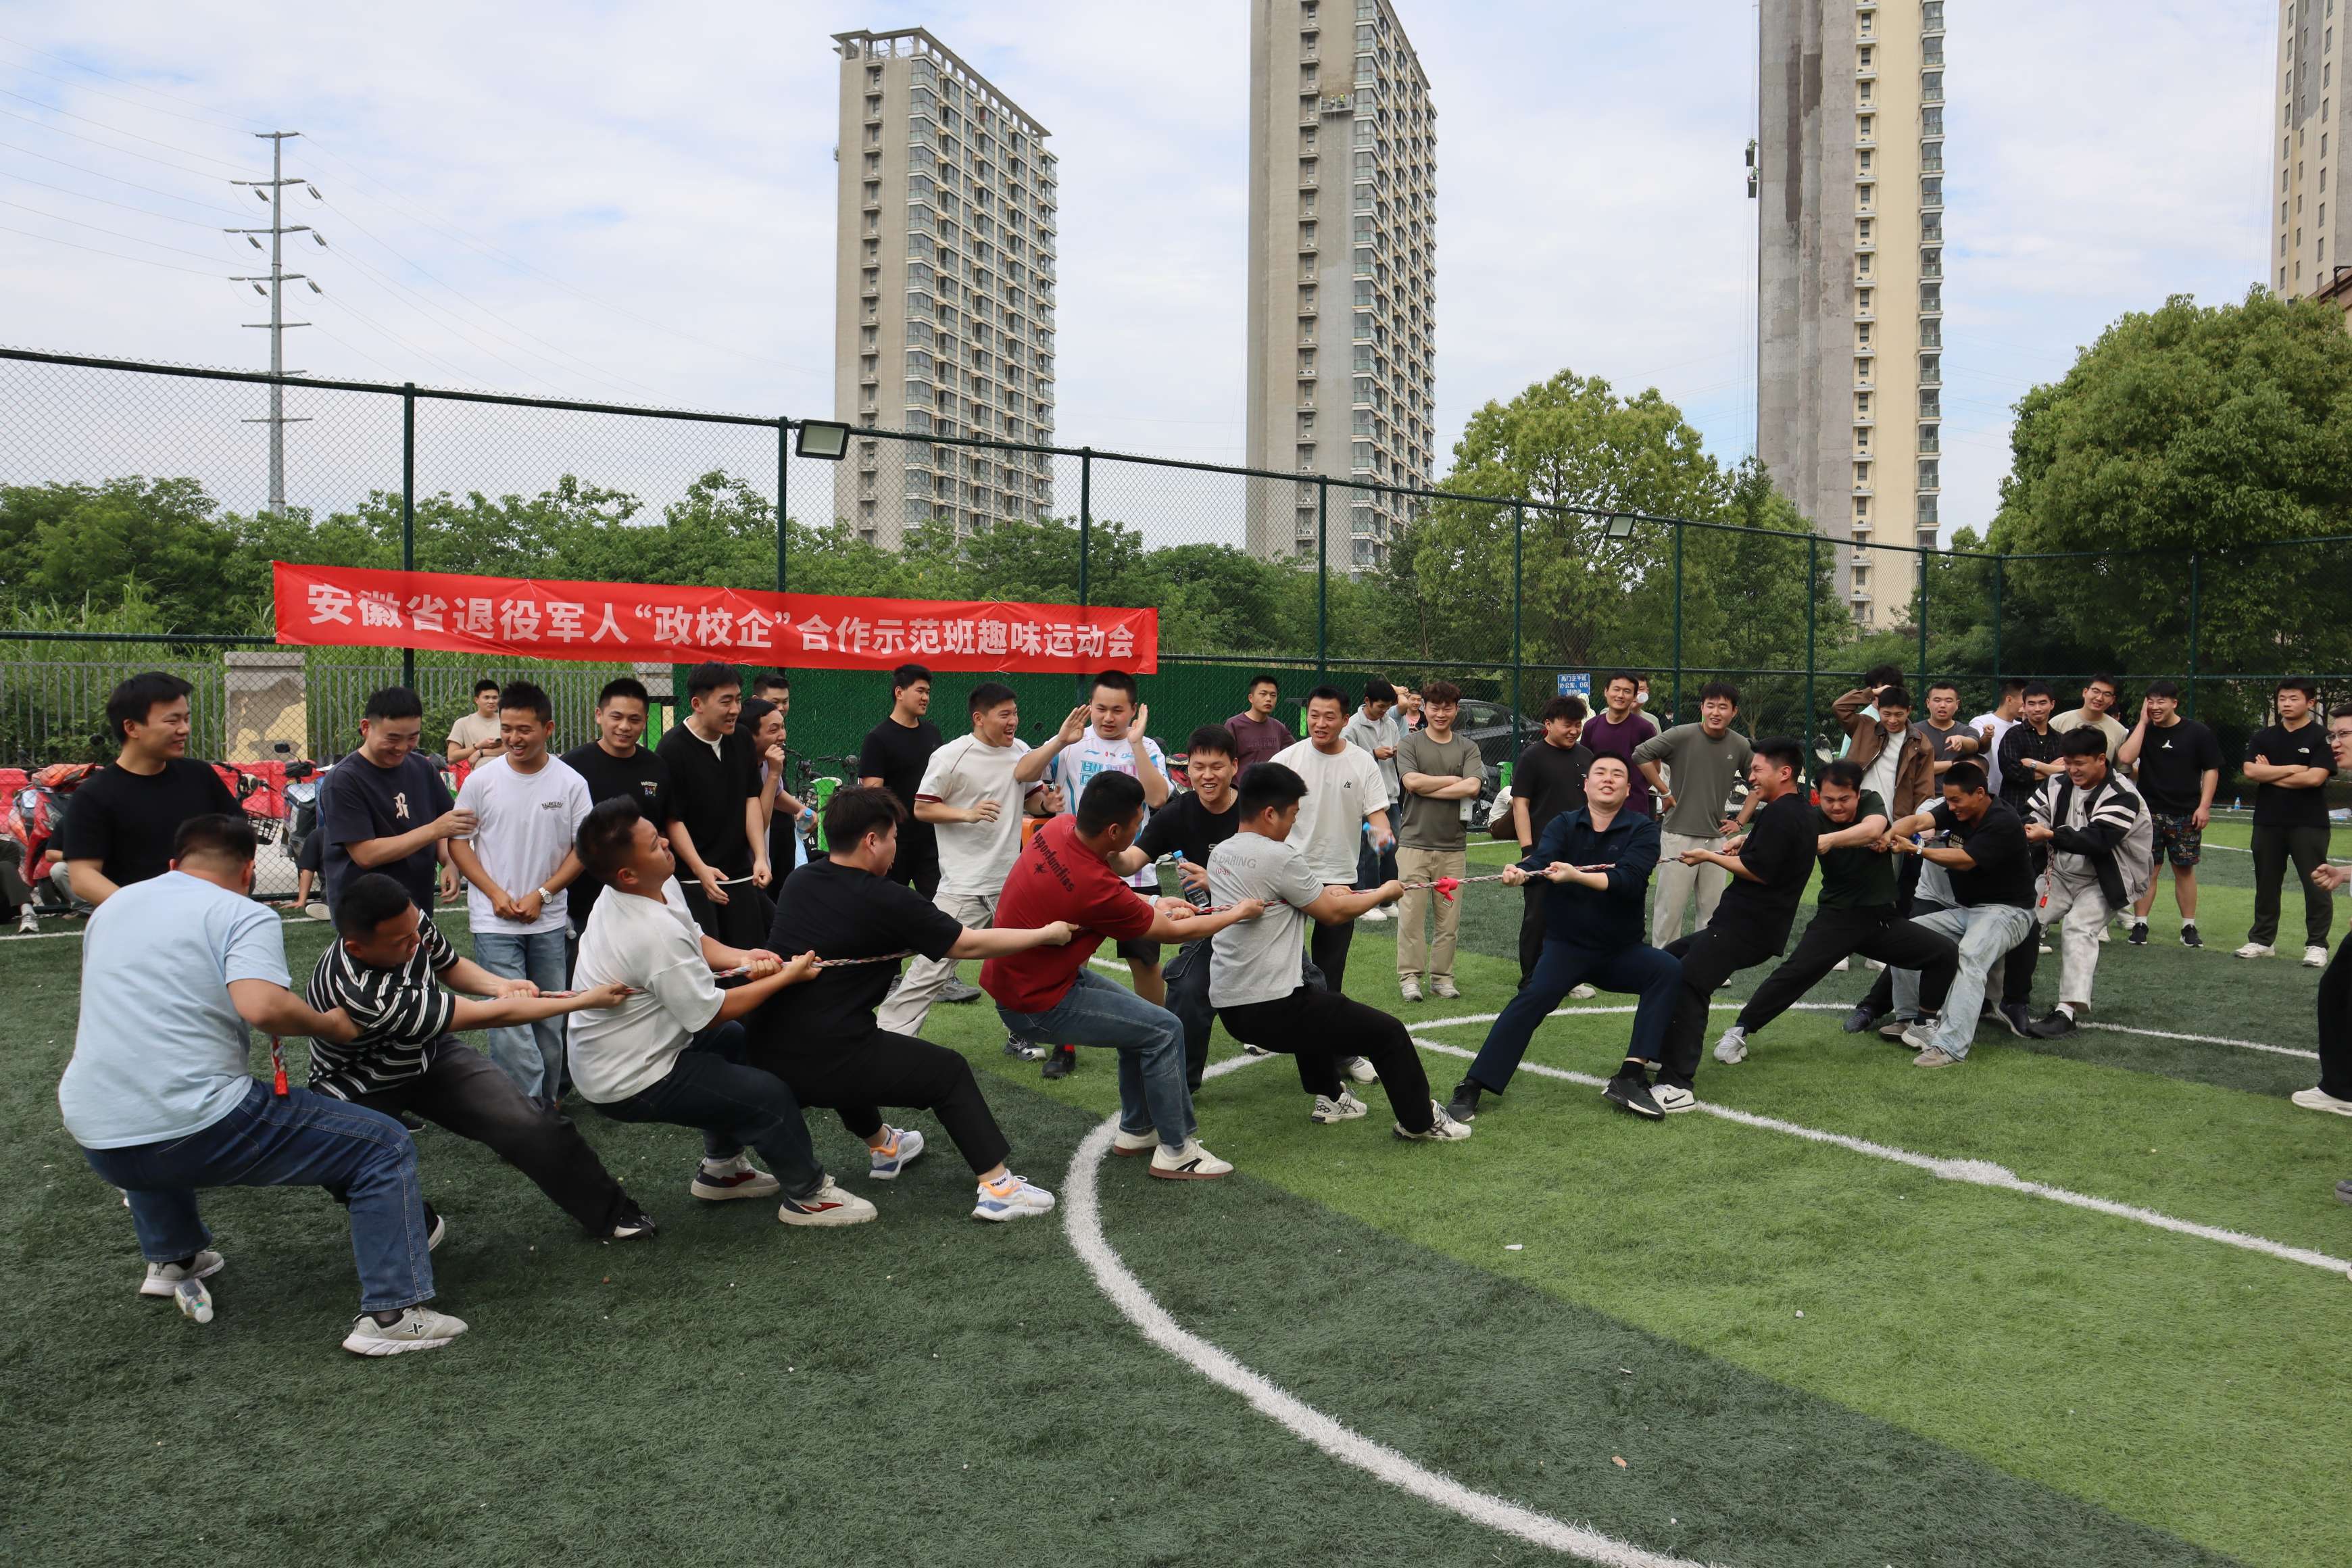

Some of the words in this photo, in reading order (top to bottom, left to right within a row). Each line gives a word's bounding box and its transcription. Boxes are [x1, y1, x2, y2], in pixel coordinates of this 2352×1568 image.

[307, 583, 1135, 659] 安徽省退役军人“政校企”合作示范班趣味运动会
